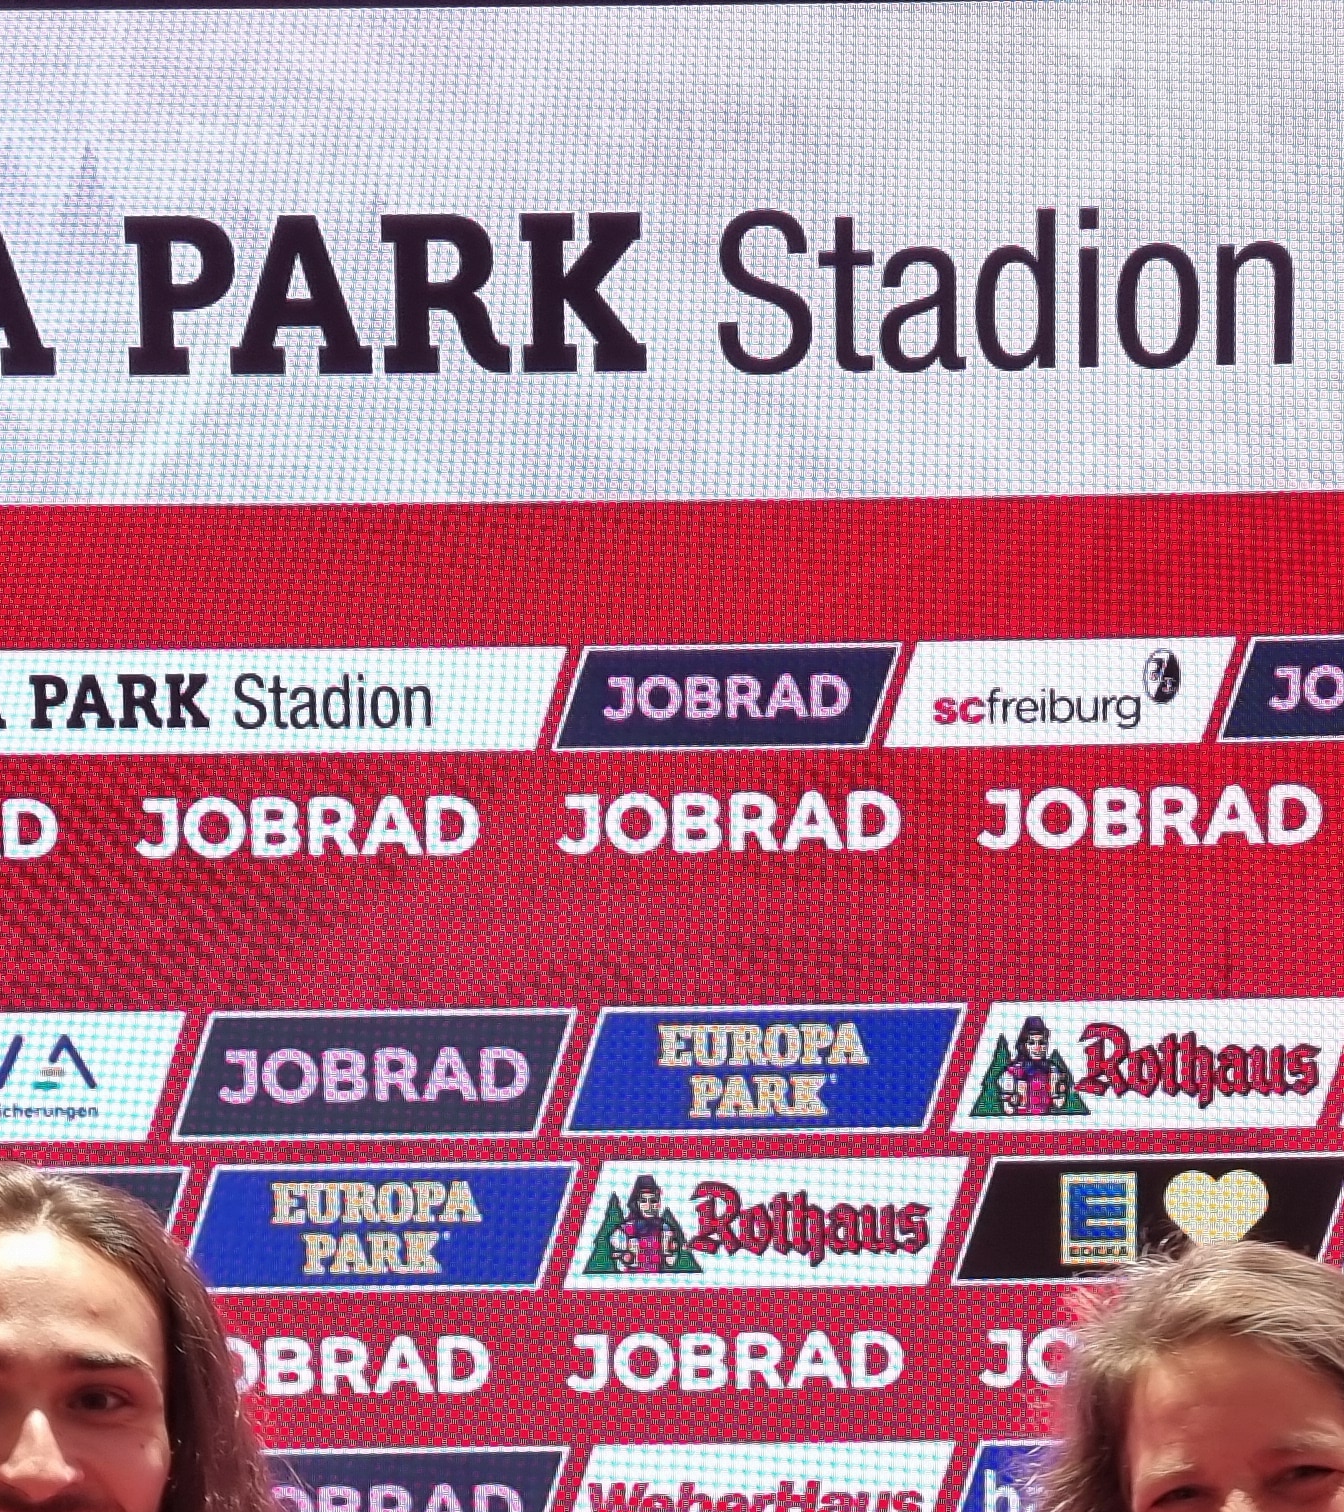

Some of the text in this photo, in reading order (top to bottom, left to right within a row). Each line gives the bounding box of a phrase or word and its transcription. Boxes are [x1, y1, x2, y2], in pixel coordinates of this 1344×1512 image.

[123, 211, 648, 377] PARK
[716, 206, 1294, 375] Stadion
[30, 673, 210, 730] PARK
[233, 672, 434, 731] Stadion
[603, 673, 851, 722] JOBRAD
[933, 687, 1141, 729] scfreiburg
[135, 796, 481, 860] JOBRAD
[556, 791, 900, 857] JOBRAD
[976, 784, 1324, 851] JOBRAD
[218, 1046, 531, 1104] JOBRAD
[658, 1023, 870, 1067] EUROPA
[1074, 1021, 1322, 1109] Rothaus
[271, 1180, 481, 1226] EUROPA
[687, 1180, 931, 1266] Rothaus
[566, 1328, 906, 1394] JOBRAD
